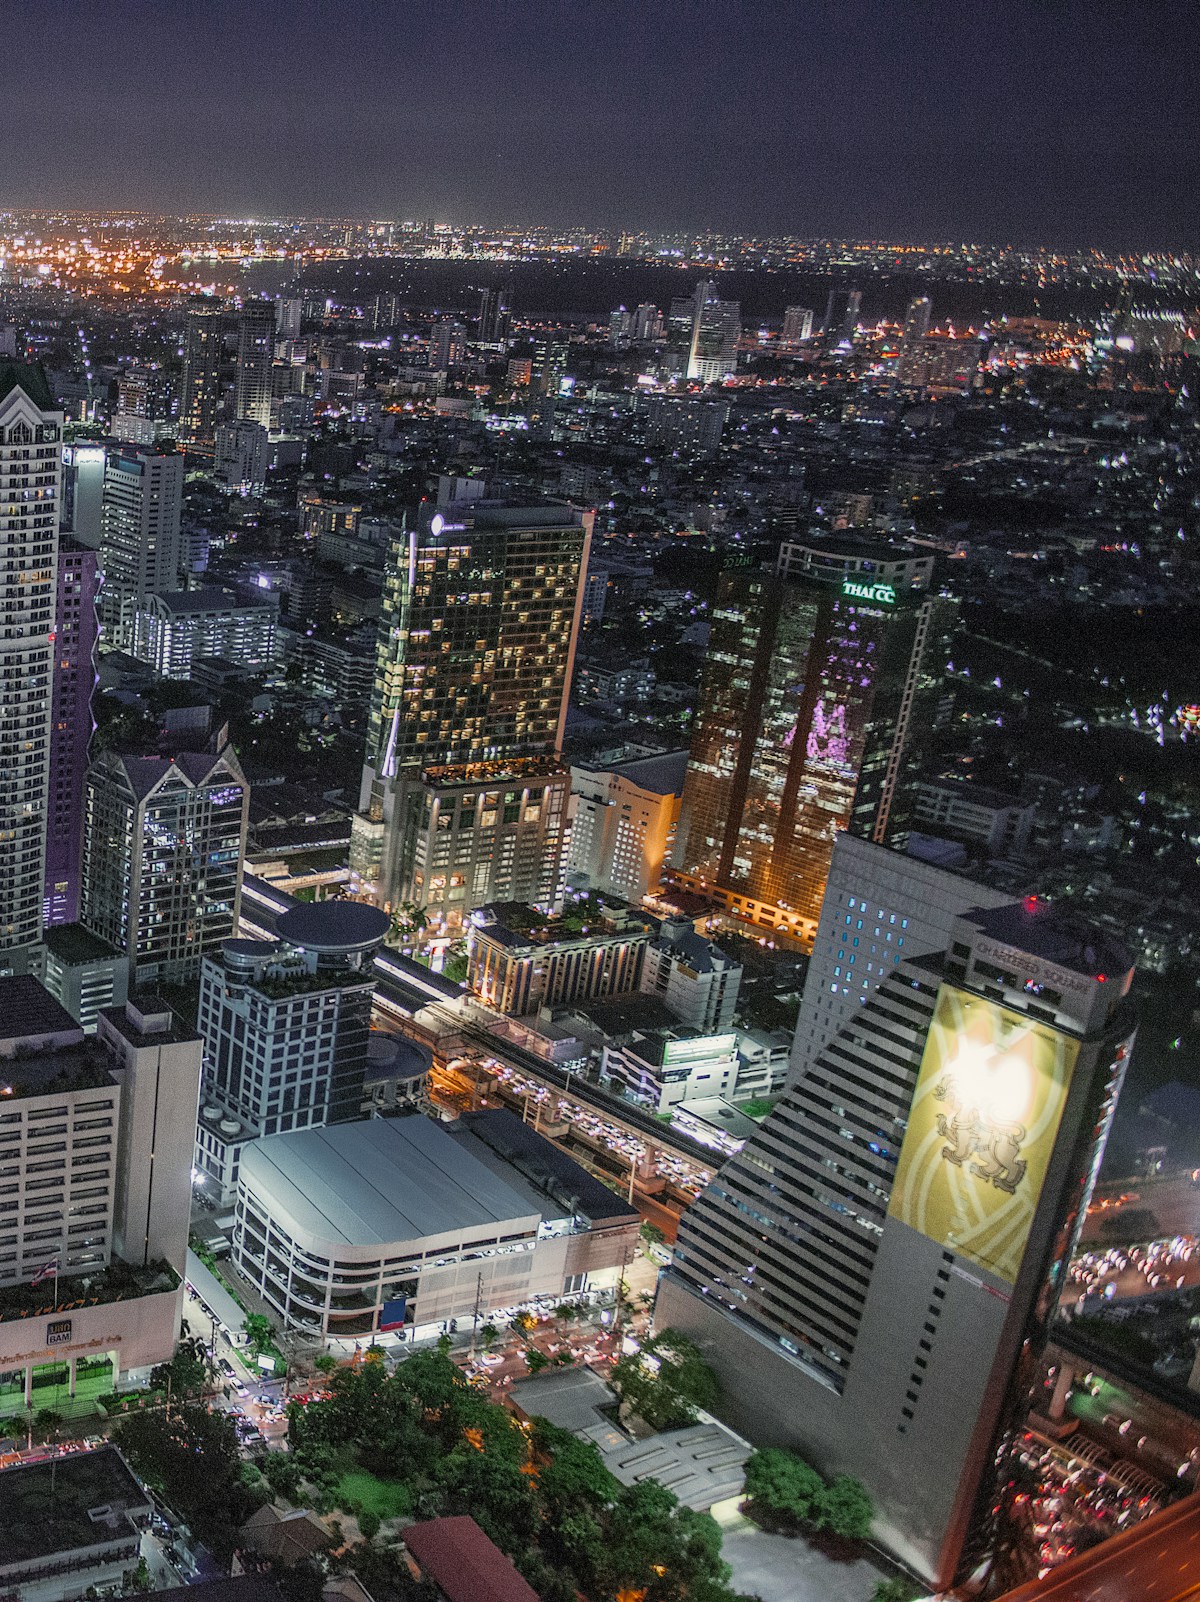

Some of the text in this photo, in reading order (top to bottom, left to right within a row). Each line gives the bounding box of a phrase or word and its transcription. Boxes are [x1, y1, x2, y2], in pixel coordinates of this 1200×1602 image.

[843, 582, 875, 599] THAI
[875, 590, 896, 603] CC
[976, 943, 1089, 994] CHARTERED SQUARE
[49, 1333, 70, 1344] BAM
